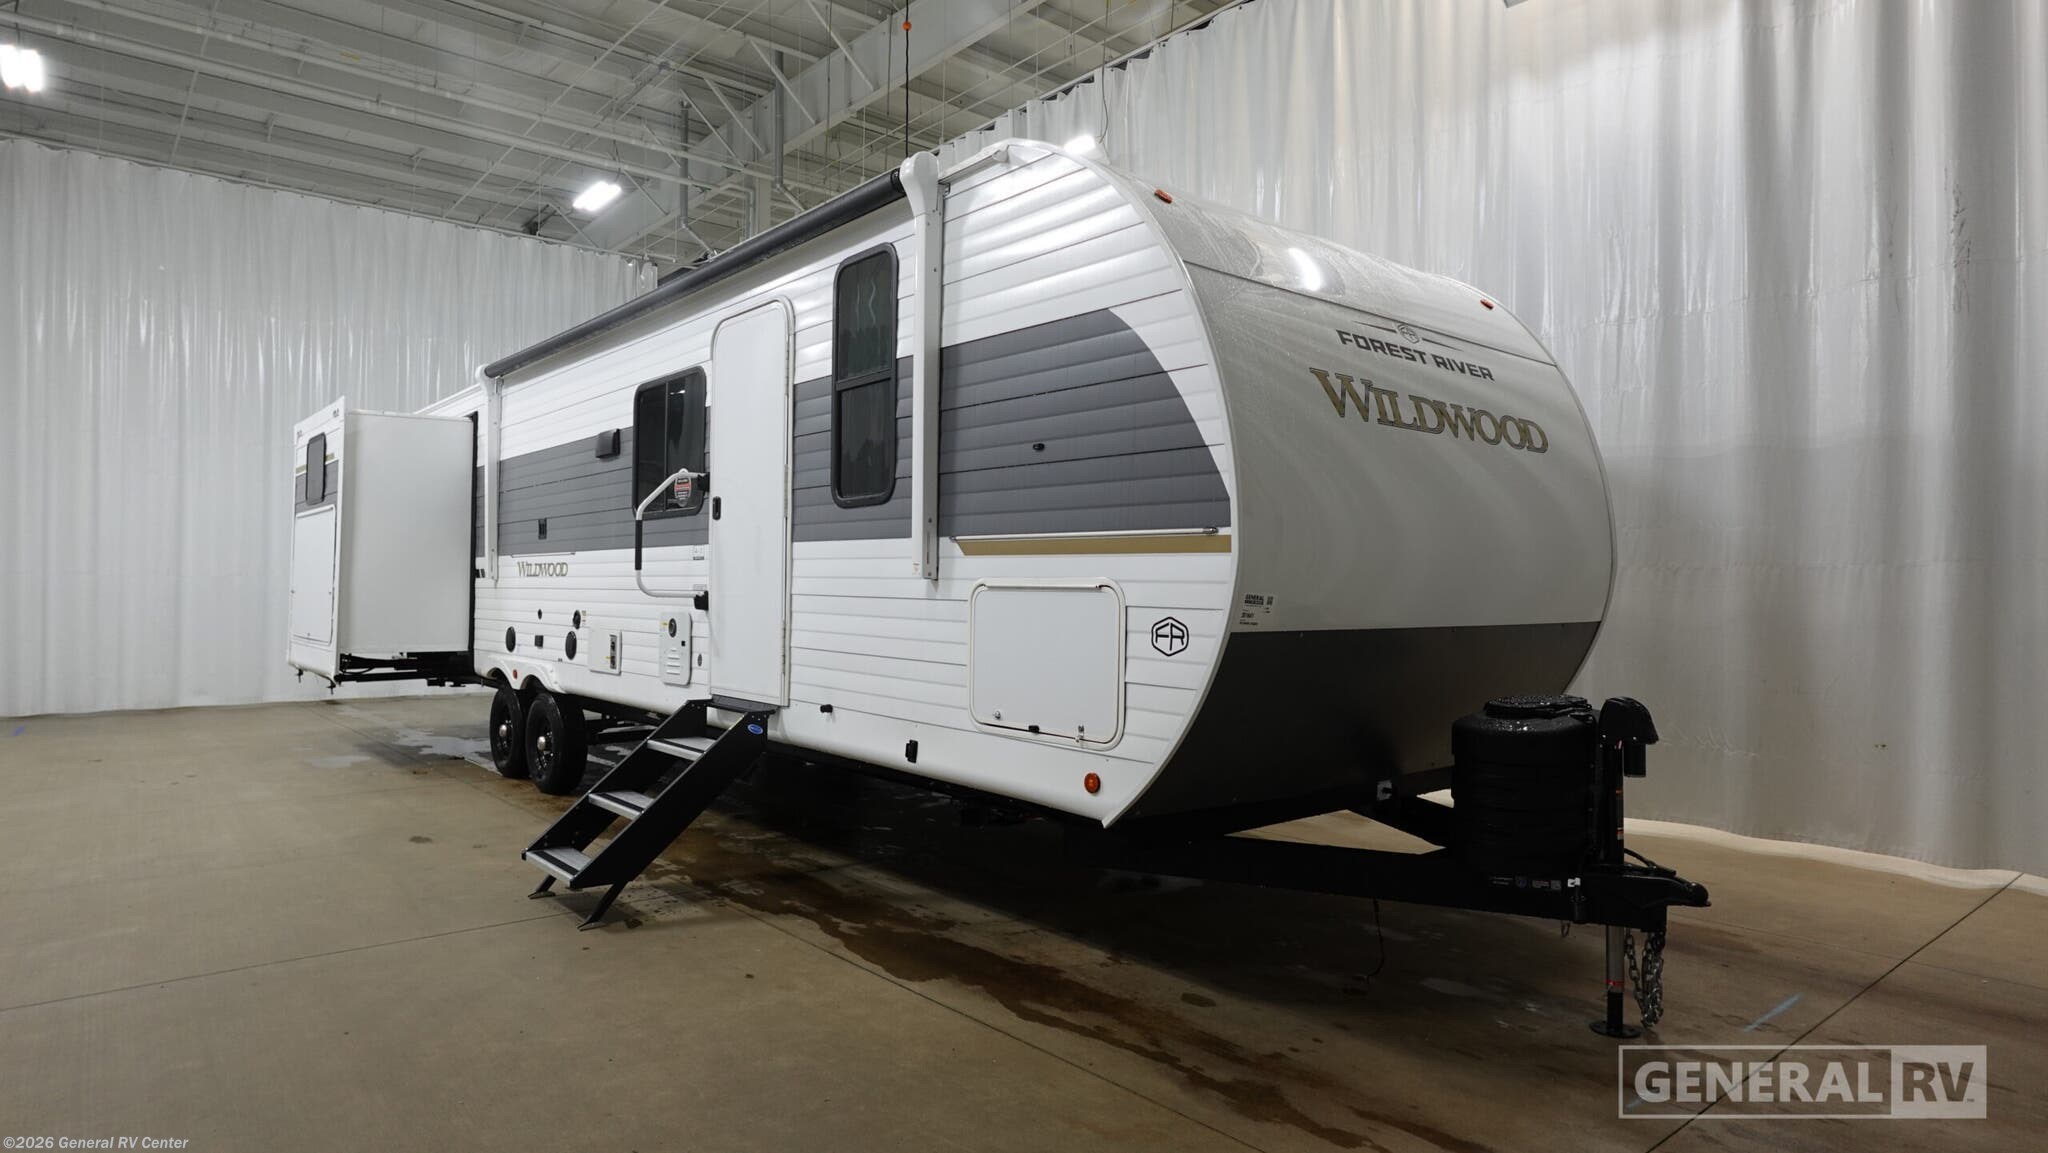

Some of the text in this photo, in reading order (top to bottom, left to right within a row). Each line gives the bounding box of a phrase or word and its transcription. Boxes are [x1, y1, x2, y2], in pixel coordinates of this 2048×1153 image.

[1336, 330, 1496, 382] FOREST RIVER
[1309, 366, 1549, 454] WILDWOOD
[516, 560, 569, 577] WILDWOOD
[1154, 621, 1186, 652] FR
